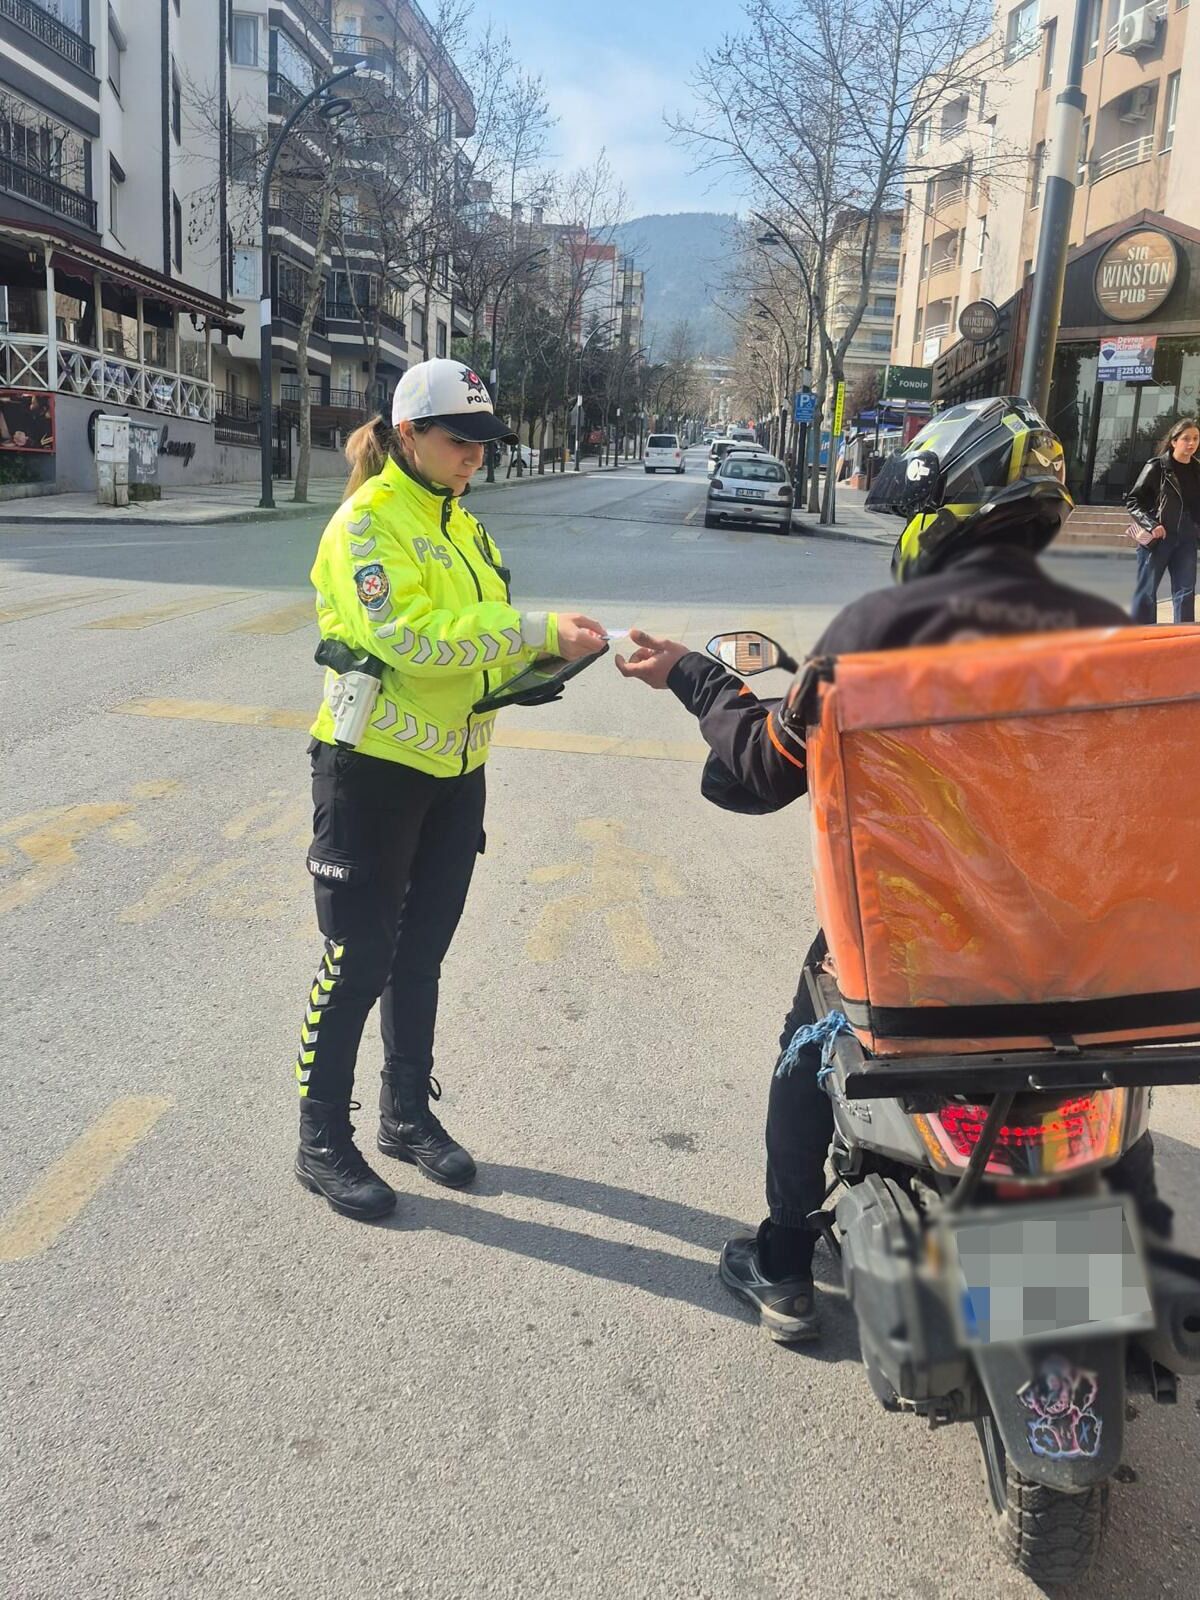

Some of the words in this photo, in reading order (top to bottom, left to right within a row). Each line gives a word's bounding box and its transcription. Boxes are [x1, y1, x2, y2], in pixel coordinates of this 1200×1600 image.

[1127, 246, 1149, 261] SIR
[1102, 261, 1172, 288] WINSTON
[1119, 288, 1146, 304] PUB
[962, 317, 993, 328] WINSTON
[1122, 367, 1134, 375] 225
[1145, 366, 1152, 374] 19
[800, 394, 810, 407] P
